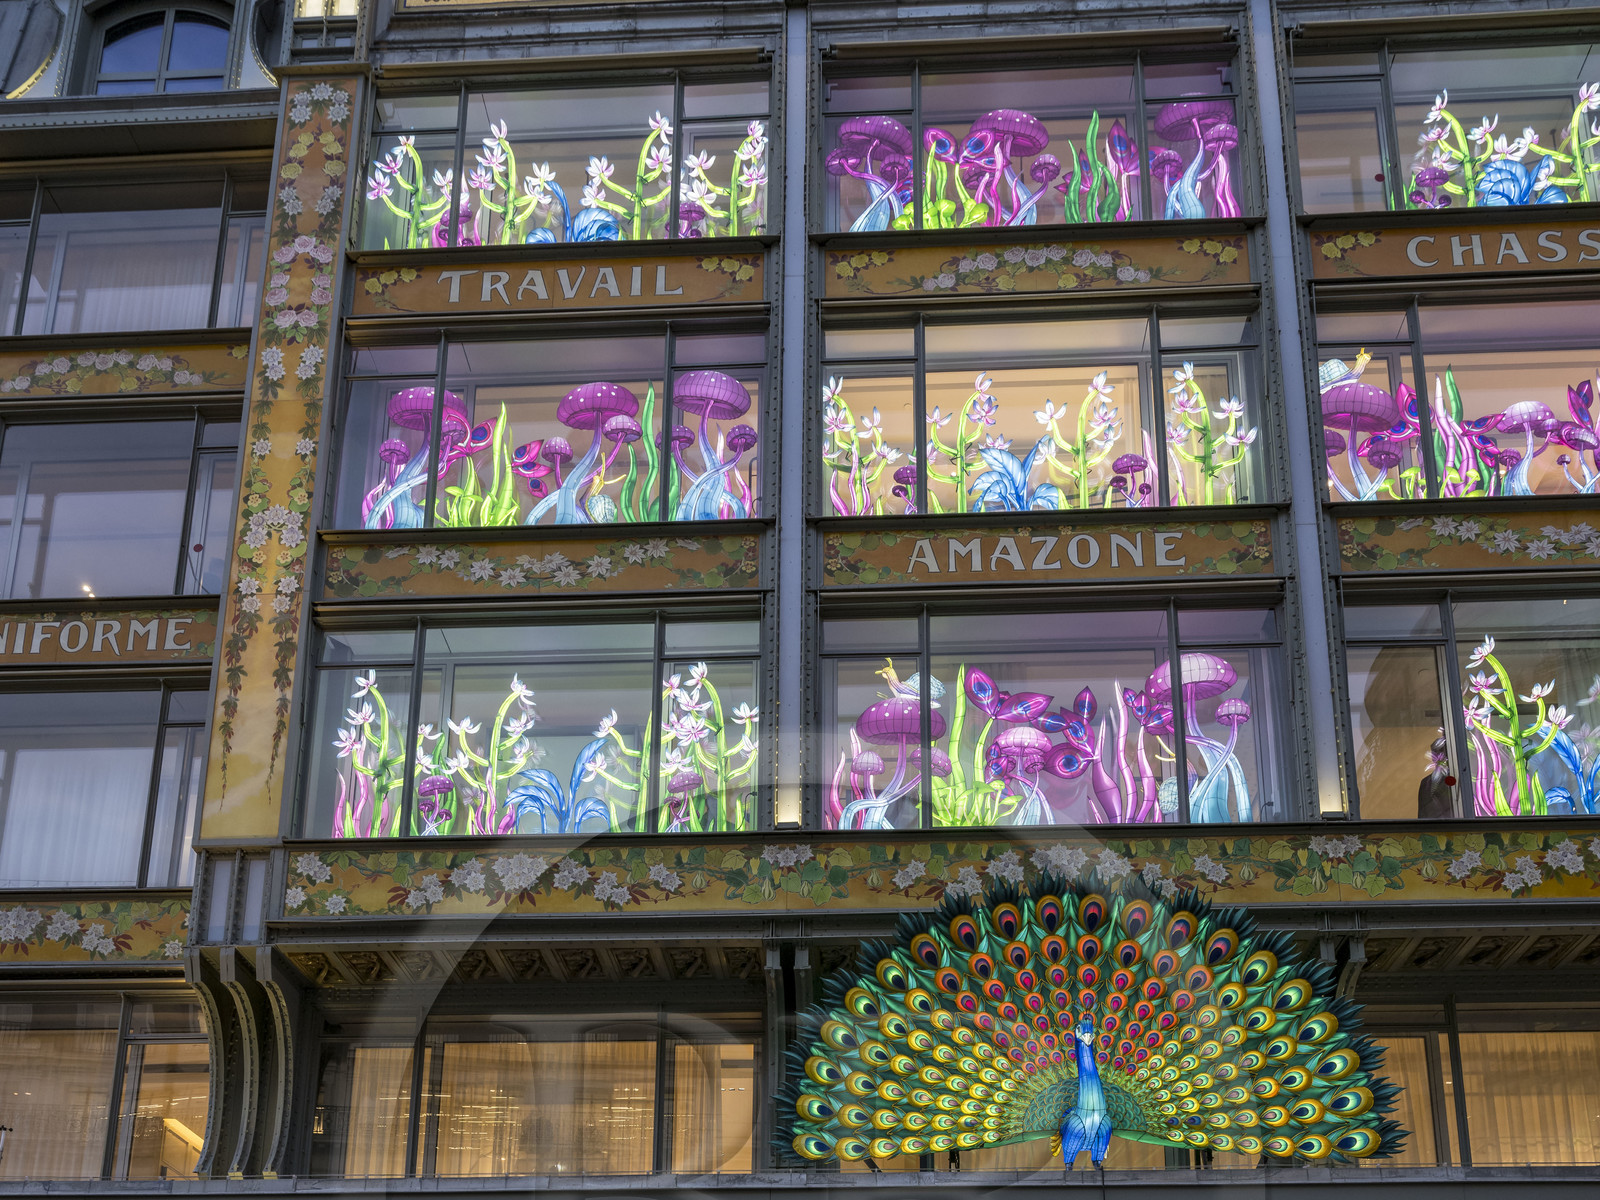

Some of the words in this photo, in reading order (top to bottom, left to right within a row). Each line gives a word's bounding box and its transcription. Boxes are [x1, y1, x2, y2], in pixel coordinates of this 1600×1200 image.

[1406, 229, 1600, 268] CHASS
[437, 265, 684, 306] TRAVAIL
[906, 531, 1187, 574] AMAZONE
